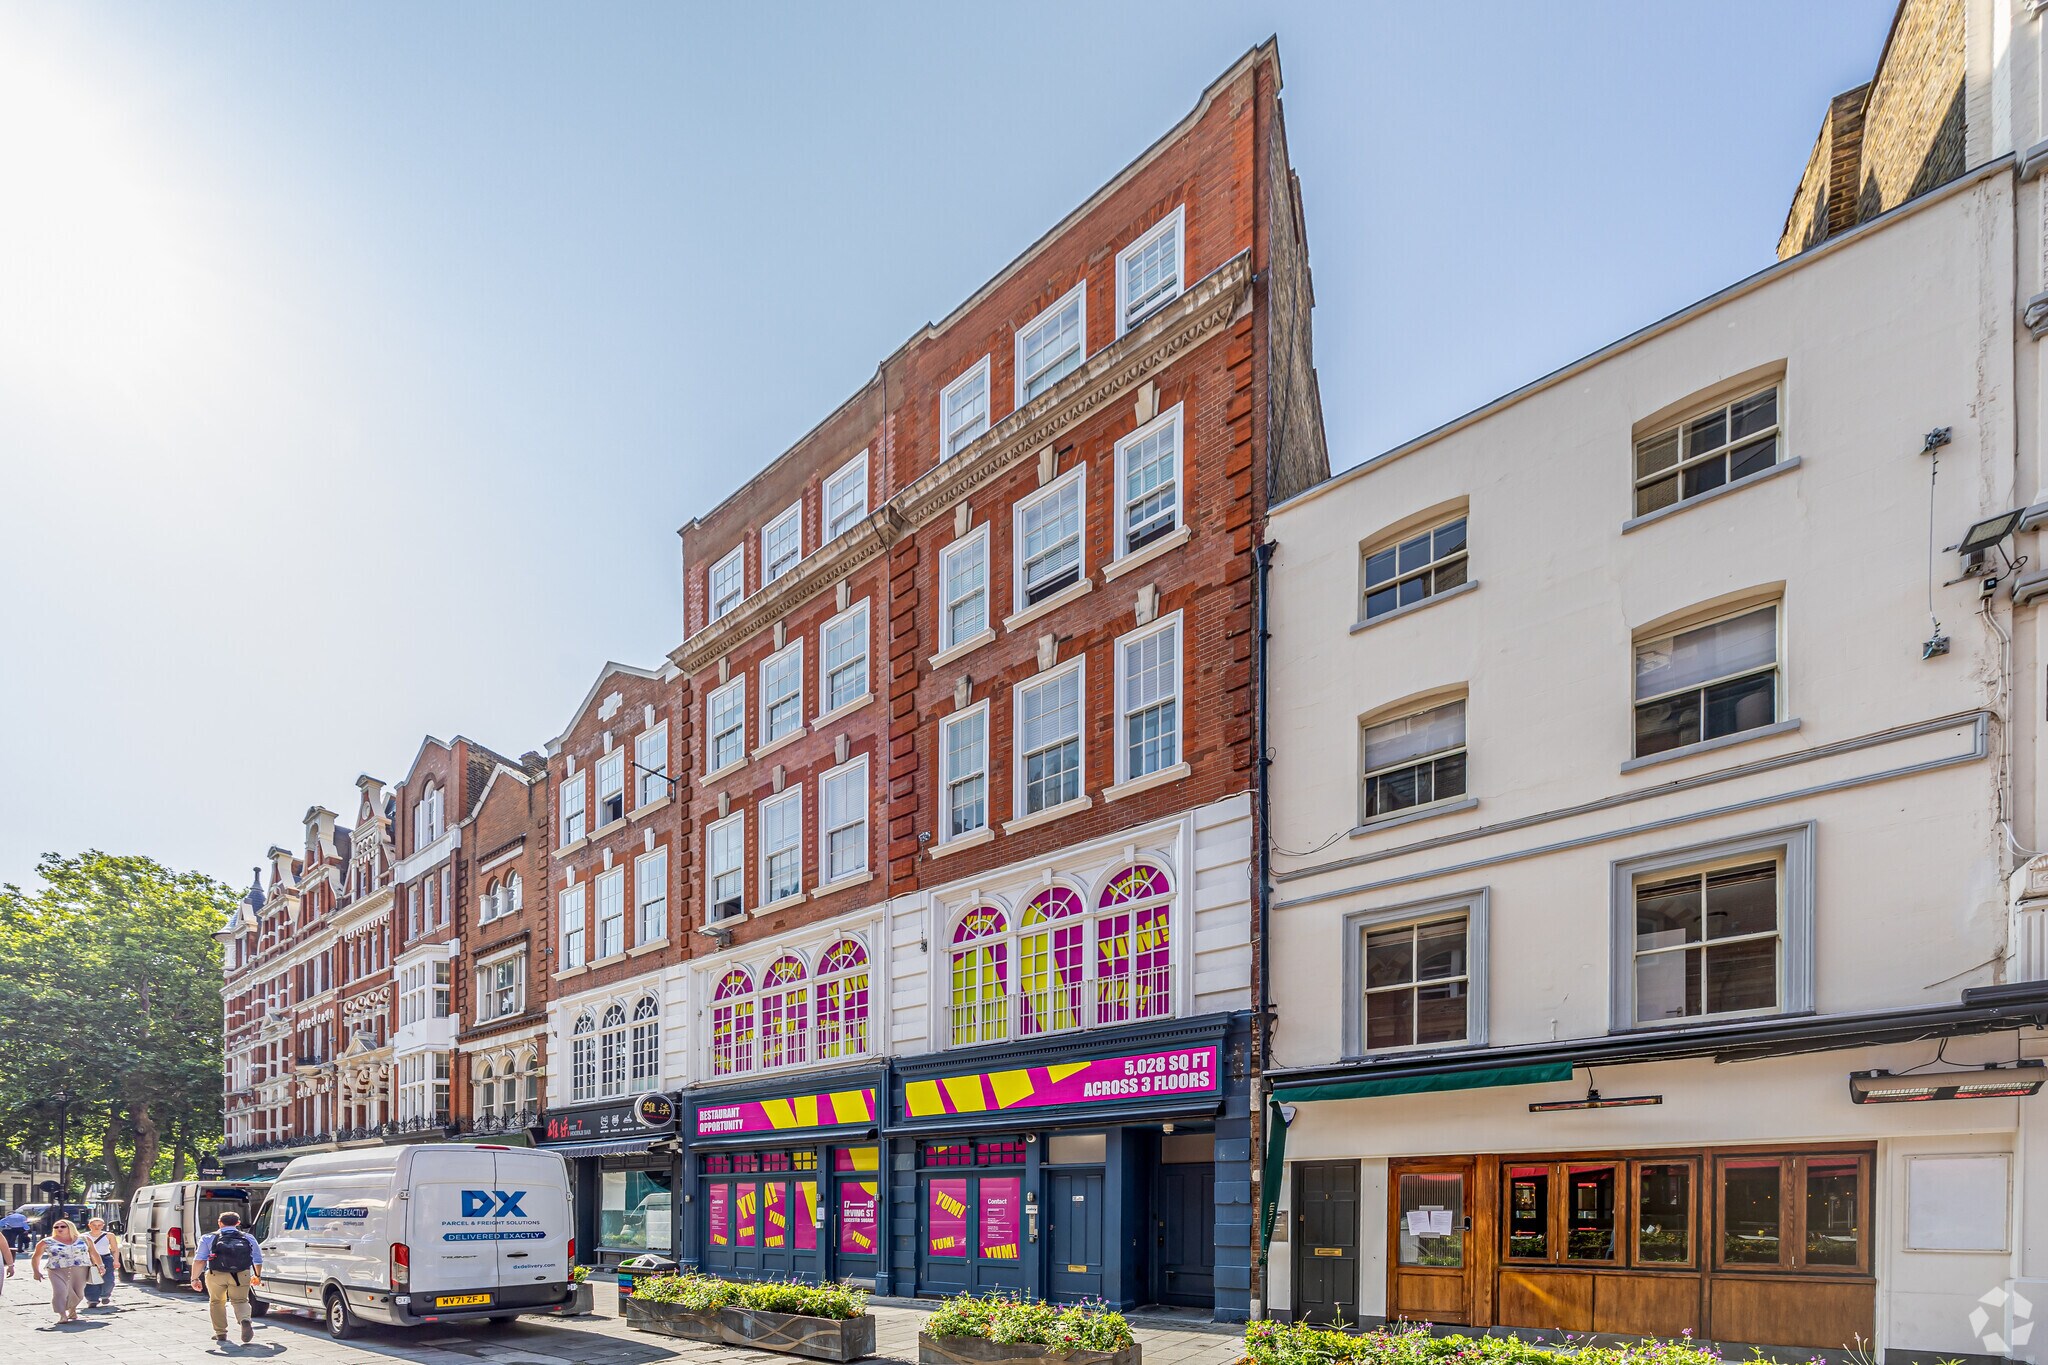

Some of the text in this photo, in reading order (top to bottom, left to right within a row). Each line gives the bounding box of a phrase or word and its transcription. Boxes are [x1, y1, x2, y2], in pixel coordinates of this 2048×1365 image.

[1124, 1052, 1211, 1077] 5,028 SQ FT
[1083, 1071, 1209, 1098] ACROSS 3 FLOORS
[699, 1107, 740, 1121] RESTAURANT
[699, 1119, 744, 1133] OPPORTUNITY
[461, 1190, 528, 1217] DX
[936, 1190, 966, 1219] YUM!
[284, 1194, 314, 1230] DX
[318, 1209, 342, 1217] DELIVERED
[843, 1208, 875, 1217] IRVING ST
[448, 1233, 501, 1241] DELIVERED
[738, 1225, 755, 1238] YUM!
[764, 1234, 785, 1248] YUM!
[851, 1230, 872, 1249] YUM!
[931, 1236, 956, 1251] YUM!
[984, 1243, 1018, 1259] YUM!
[512, 1262, 556, 1270] dxdelivery.com
[442, 1295, 485, 1305] WV71 ZFJ
